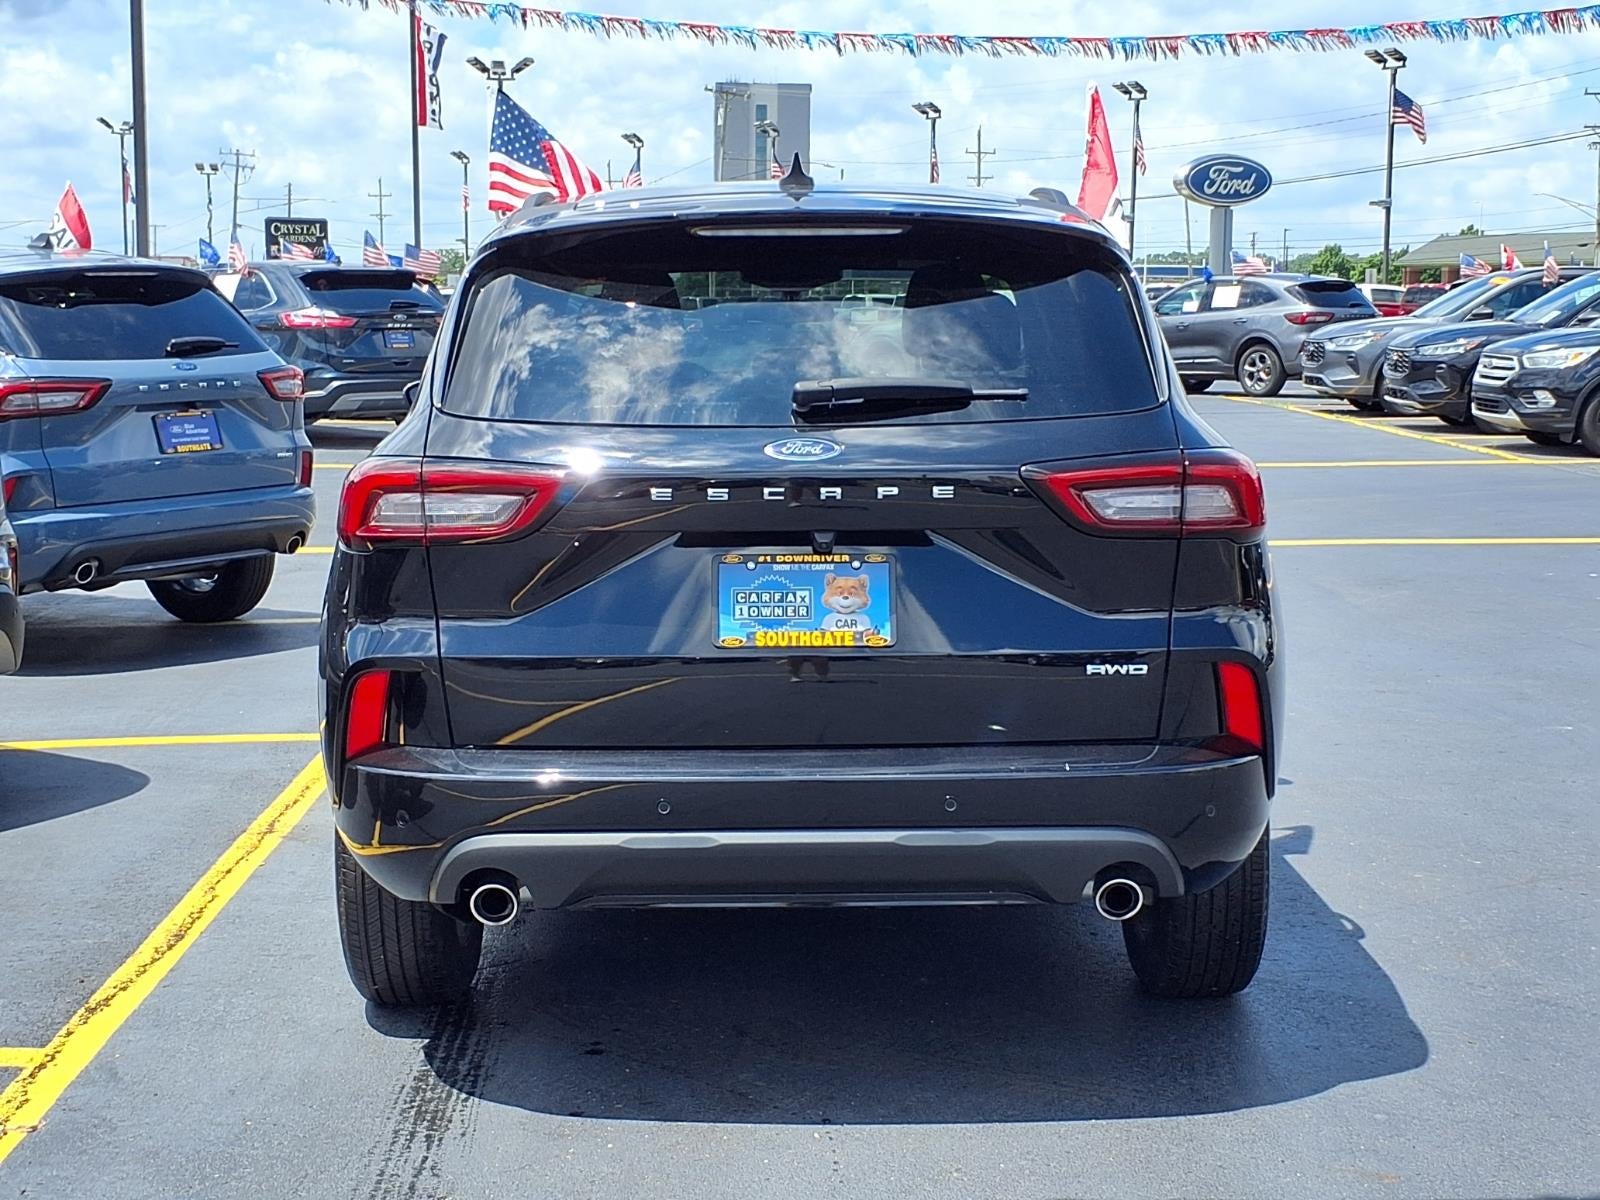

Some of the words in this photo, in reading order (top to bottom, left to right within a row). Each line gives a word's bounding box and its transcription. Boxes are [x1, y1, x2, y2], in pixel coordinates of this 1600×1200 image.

[1204, 165, 1256, 195] Ford
[271, 222, 324, 237] CRYSTAL
[781, 441, 823, 456] Ford
[650, 485, 955, 501] ESCAPE
[758, 554, 771, 563] #1
[776, 554, 850, 563] DOWNRIVER
[736, 592, 809, 605] CARFAX
[749, 606, 809, 617] OWNER
[835, 618, 858, 629] CAR
[755, 631, 855, 647] SOUTHGATE
[1086, 664, 1149, 675] AWD
